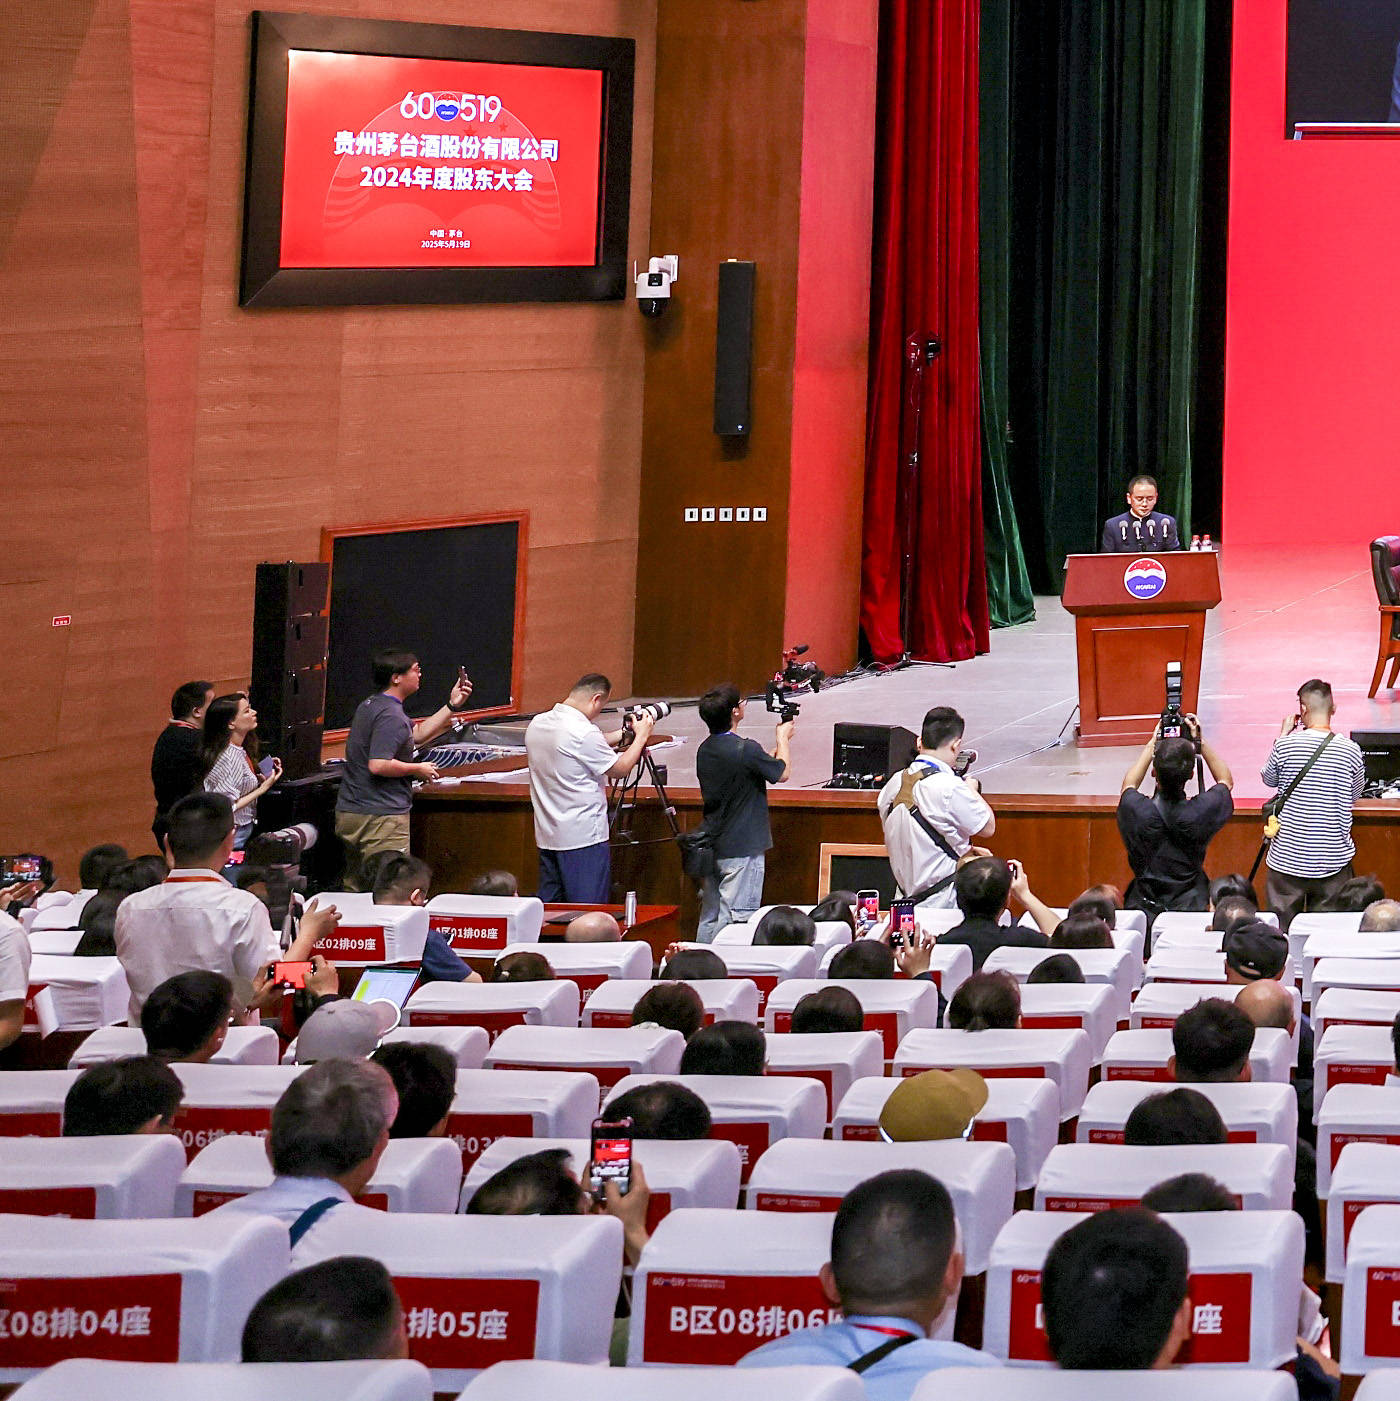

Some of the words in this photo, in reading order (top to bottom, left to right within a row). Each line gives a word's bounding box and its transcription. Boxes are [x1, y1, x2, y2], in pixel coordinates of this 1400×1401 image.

[333, 130, 560, 163] 贵州茅台酒股份有限公司
[359, 165, 533, 192] 2024年度股东大会
[313, 937, 377, 950] 区02排09座
